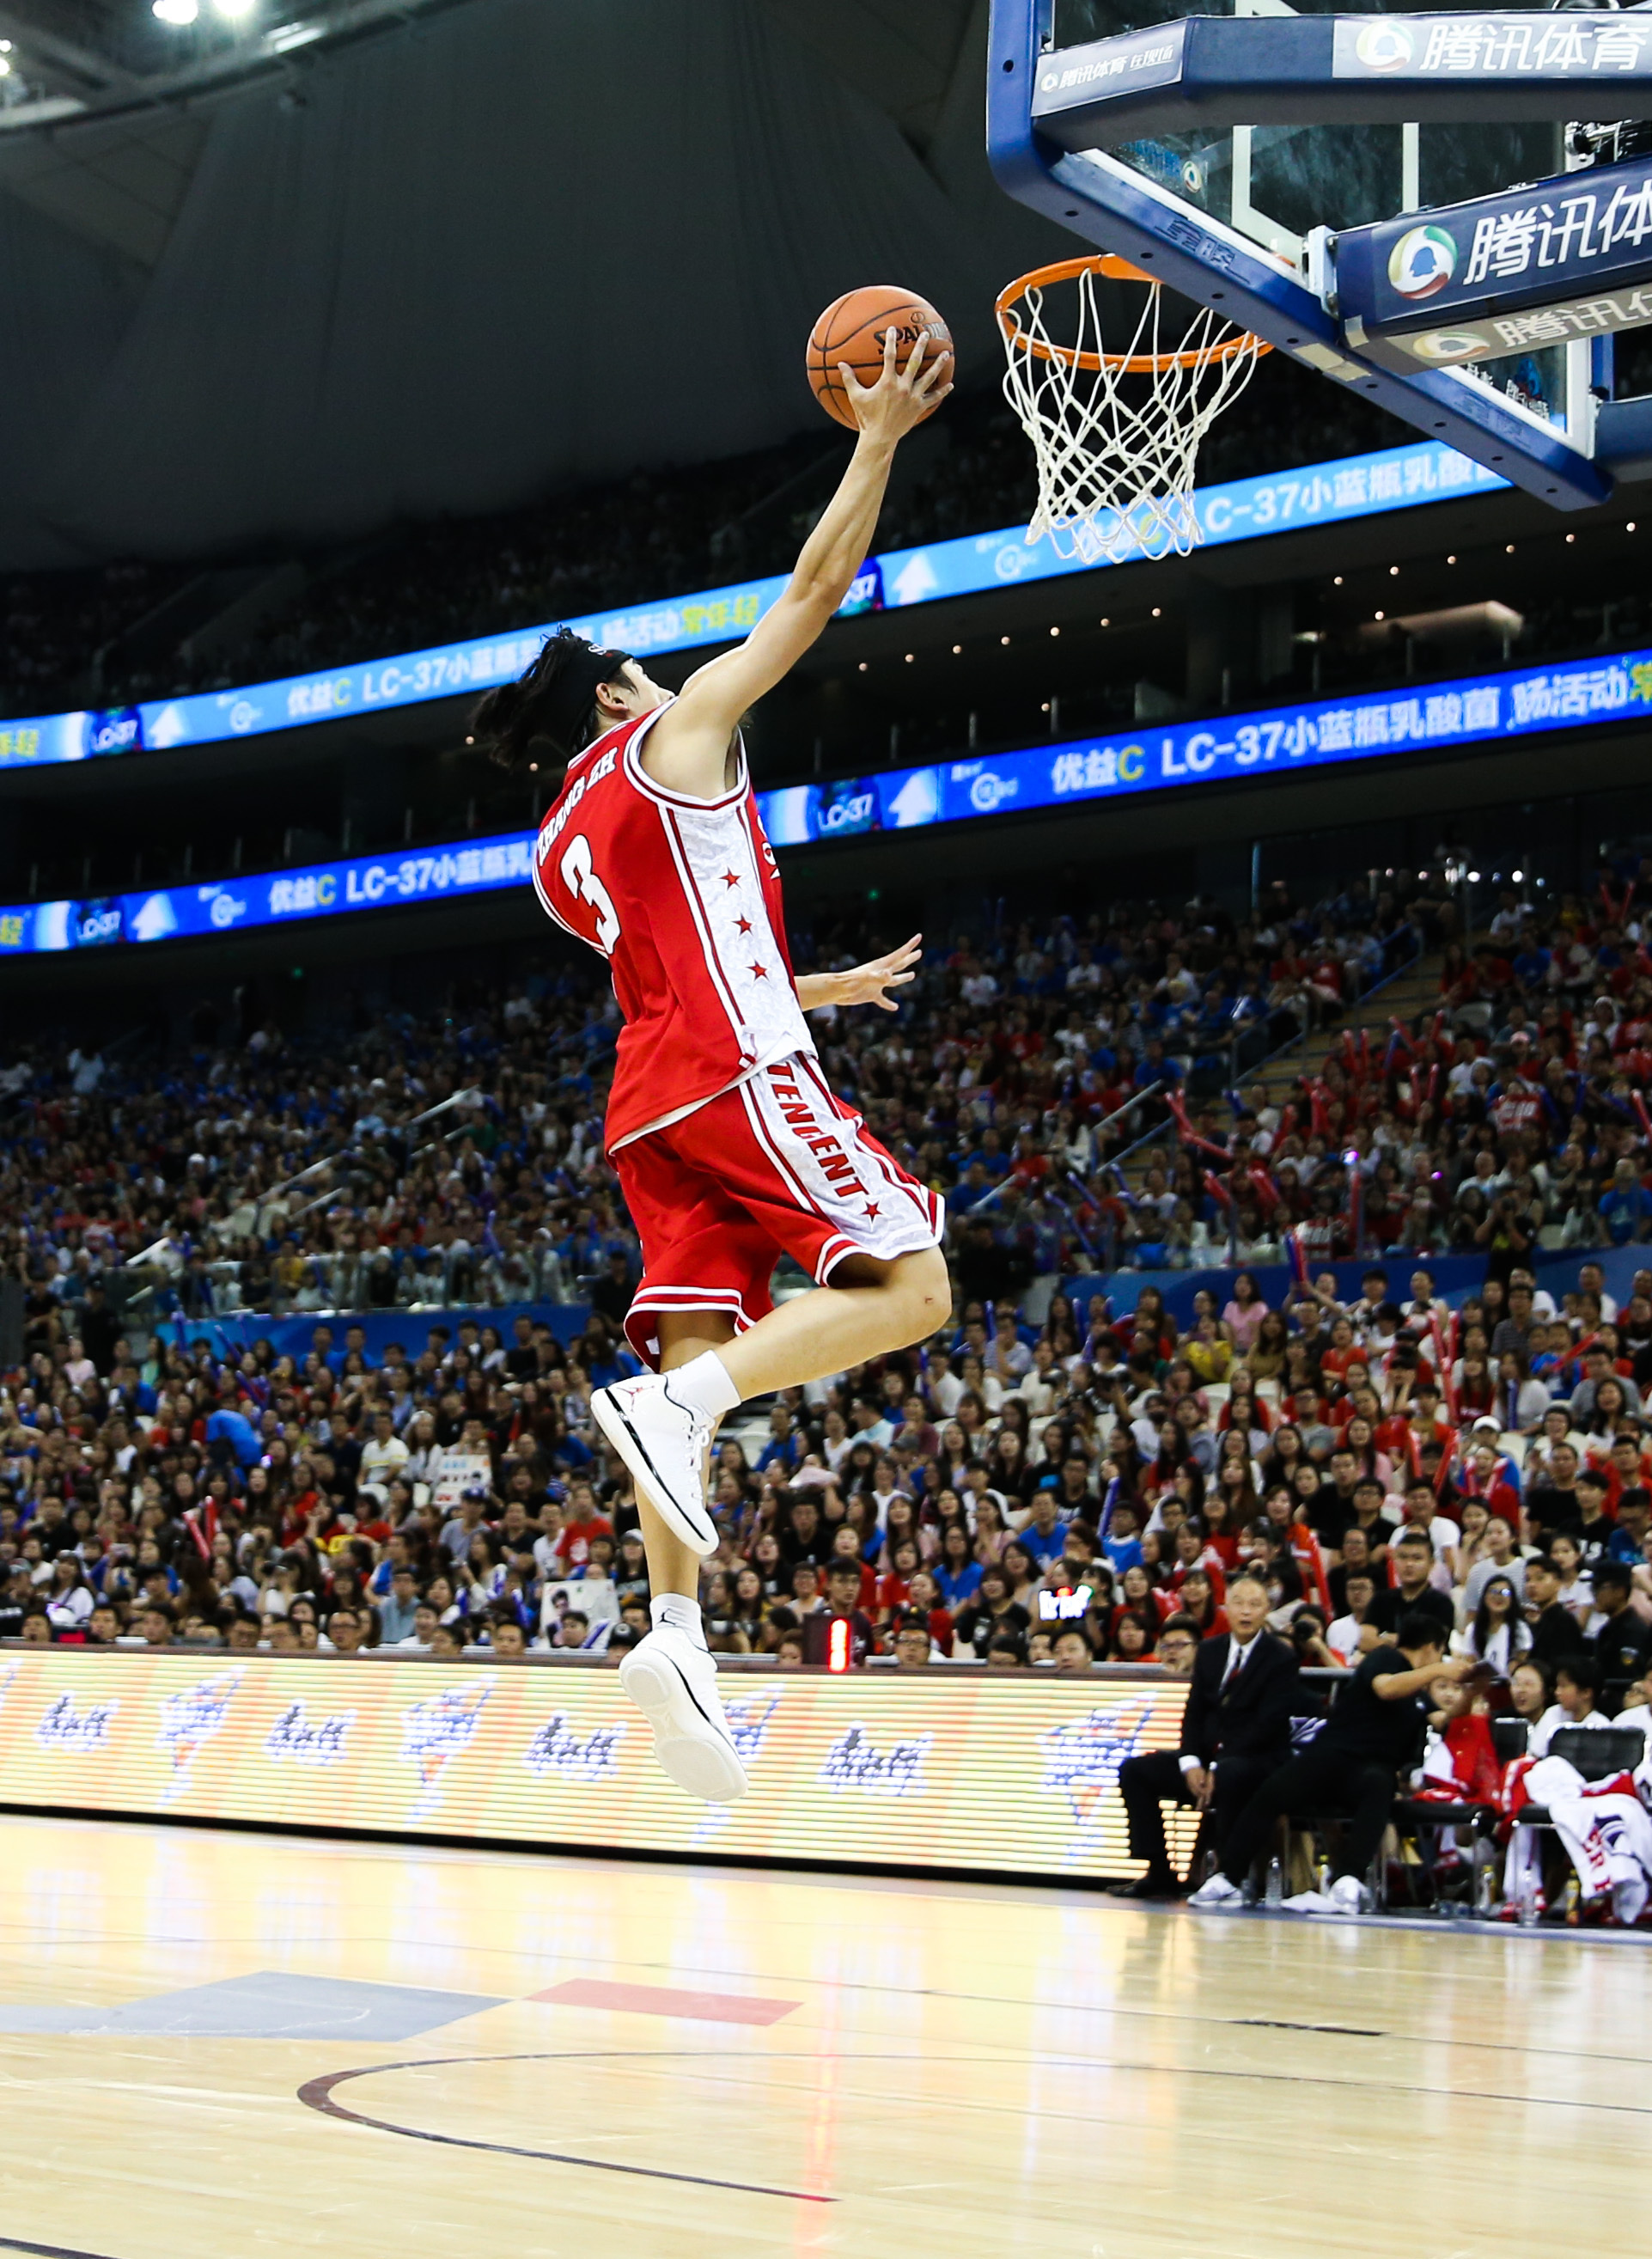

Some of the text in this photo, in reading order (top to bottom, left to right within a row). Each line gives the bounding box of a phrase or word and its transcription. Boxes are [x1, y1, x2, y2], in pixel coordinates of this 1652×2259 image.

[1058, 55, 1128, 89] 腾讯体育
[1419, 23, 1651, 71] 腾讯体育
[1051, 745, 1144, 794] 优益C
[538, 776, 586, 867] ZHANG
[560, 833, 621, 955] 3
[766, 1061, 870, 1199] TENCENT
